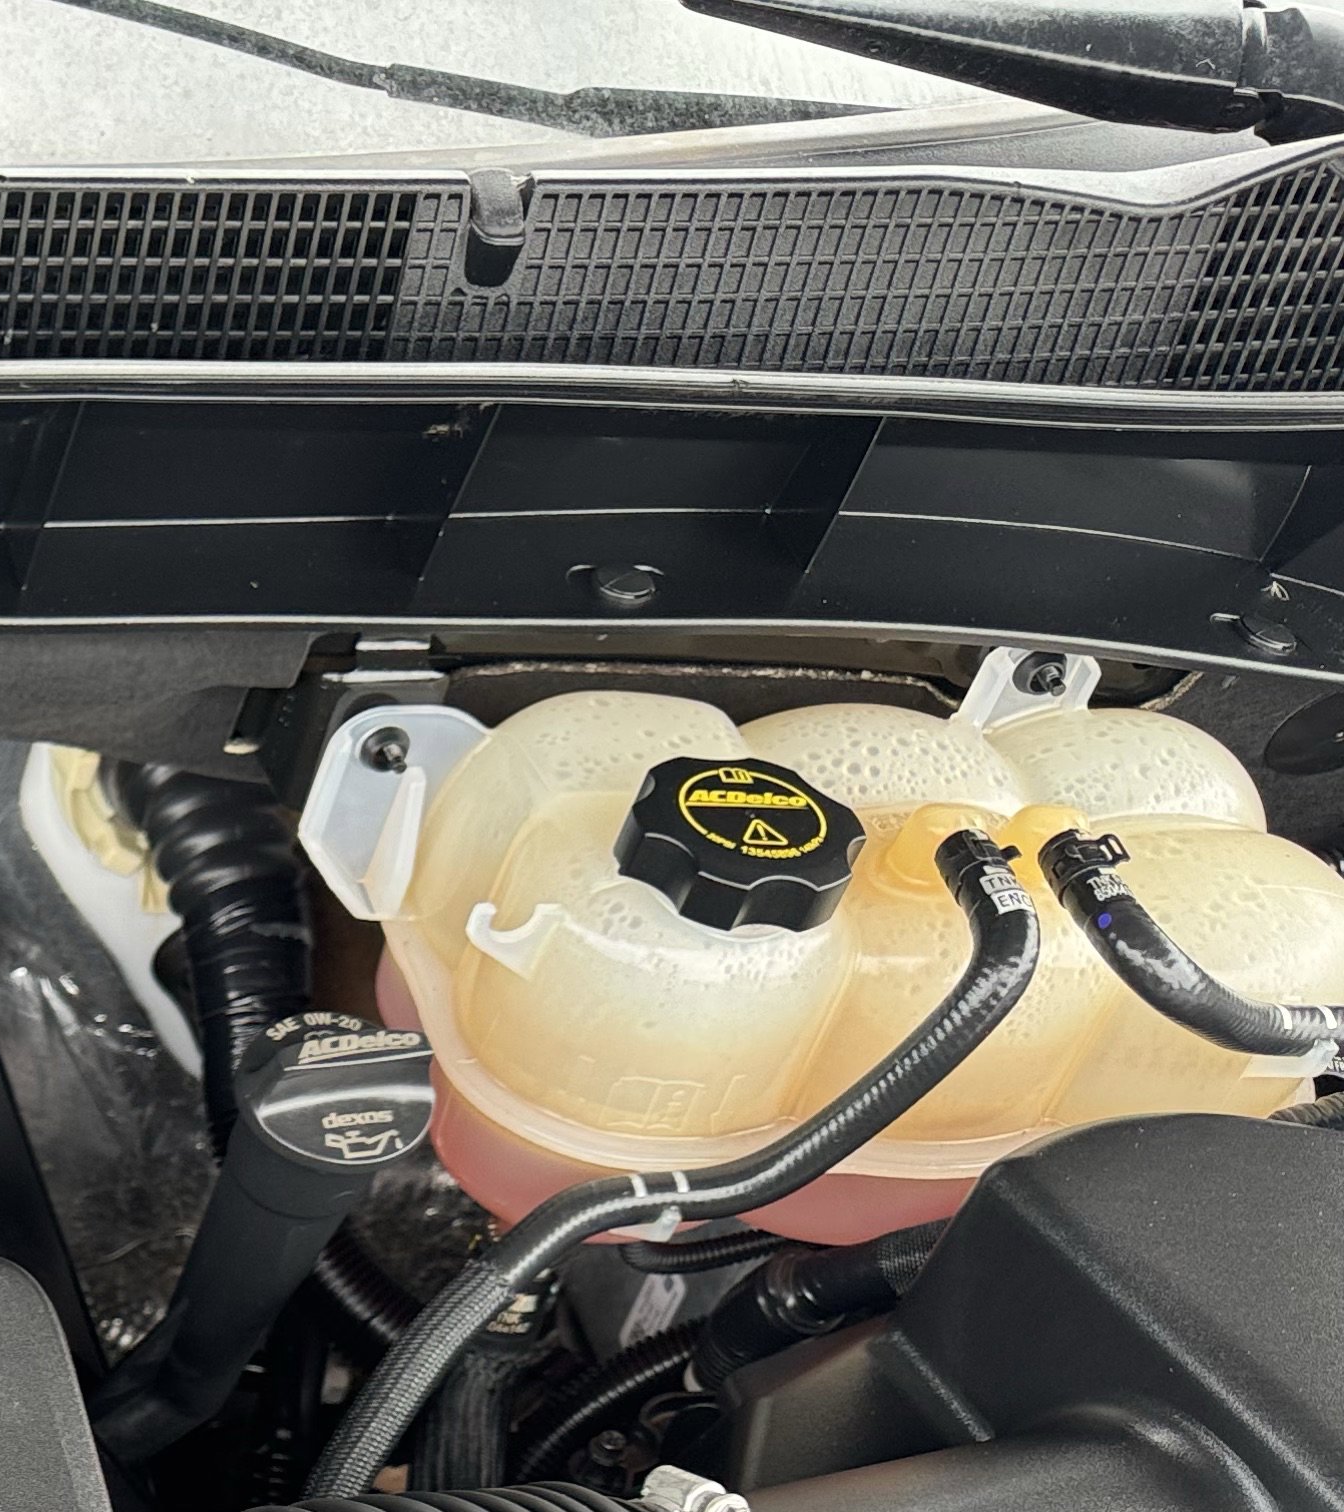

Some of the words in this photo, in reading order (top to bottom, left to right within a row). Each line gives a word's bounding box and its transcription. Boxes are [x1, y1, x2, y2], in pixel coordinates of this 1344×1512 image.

[687, 788, 808, 807] ACDelco
[265, 1016, 301, 1041] SAE
[302, 1011, 362, 1032] 0W-20
[297, 1029, 421, 1060] ACDelco
[321, 1109, 394, 1130] dexos
